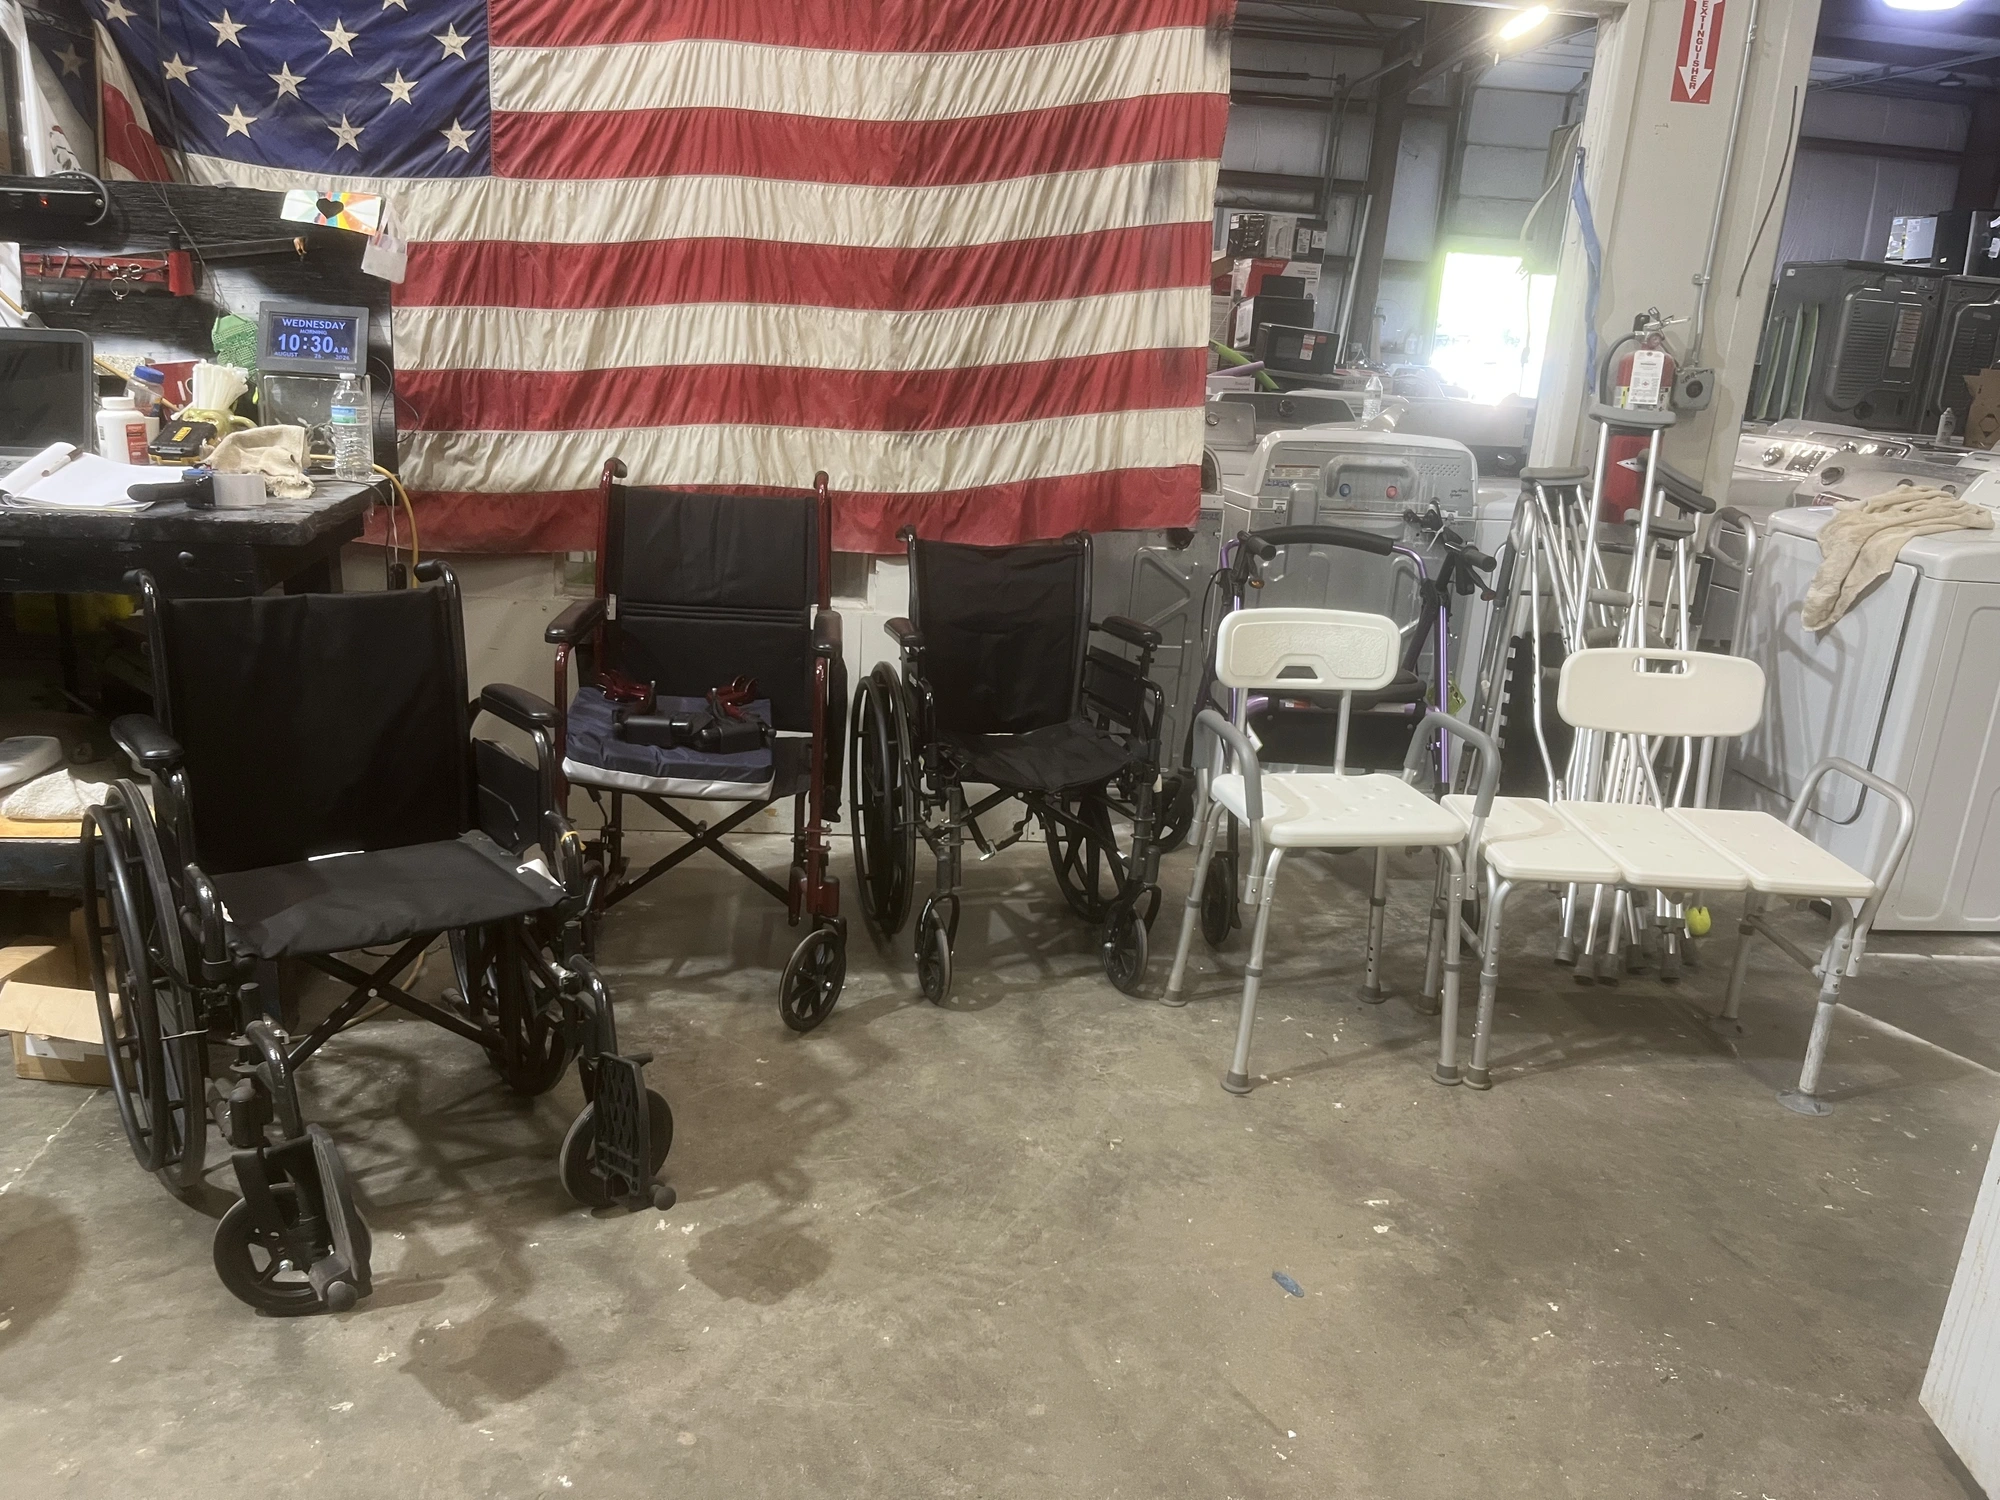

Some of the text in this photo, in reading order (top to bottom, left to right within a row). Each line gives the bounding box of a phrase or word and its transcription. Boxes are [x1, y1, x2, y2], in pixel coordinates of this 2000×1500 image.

[1689, 0, 1709, 90] EXTINGUISHER
[282, 318, 346, 330] WEDNESDAY
[278, 333, 333, 353] 10:30
